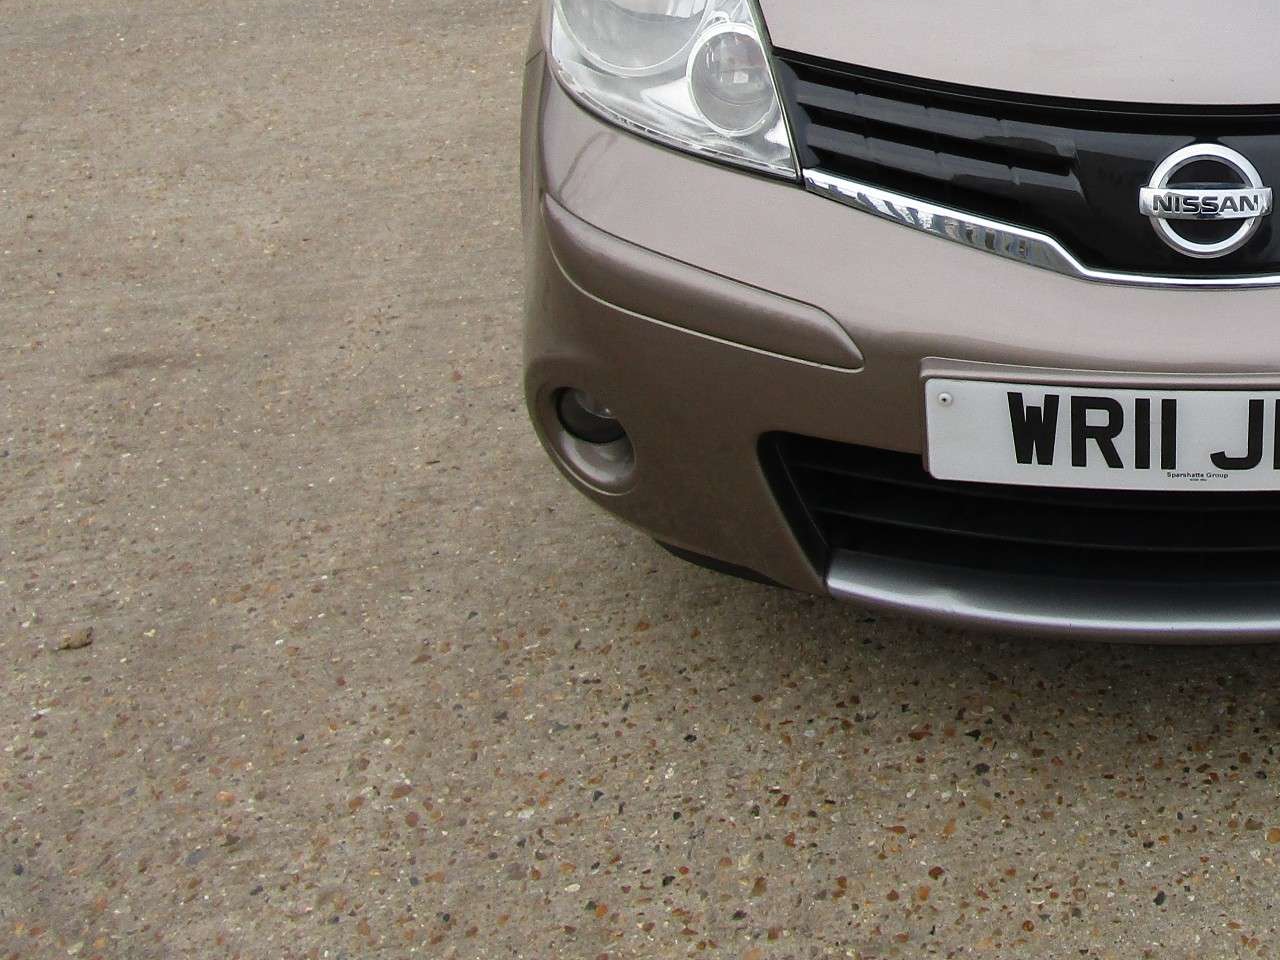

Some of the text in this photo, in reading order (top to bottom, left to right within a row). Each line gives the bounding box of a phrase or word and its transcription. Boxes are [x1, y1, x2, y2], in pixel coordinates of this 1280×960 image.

[1152, 194, 1259, 213] NISSAN
[1006, 391, 1177, 470] WR11
[1206, 471, 1229, 479] Group
